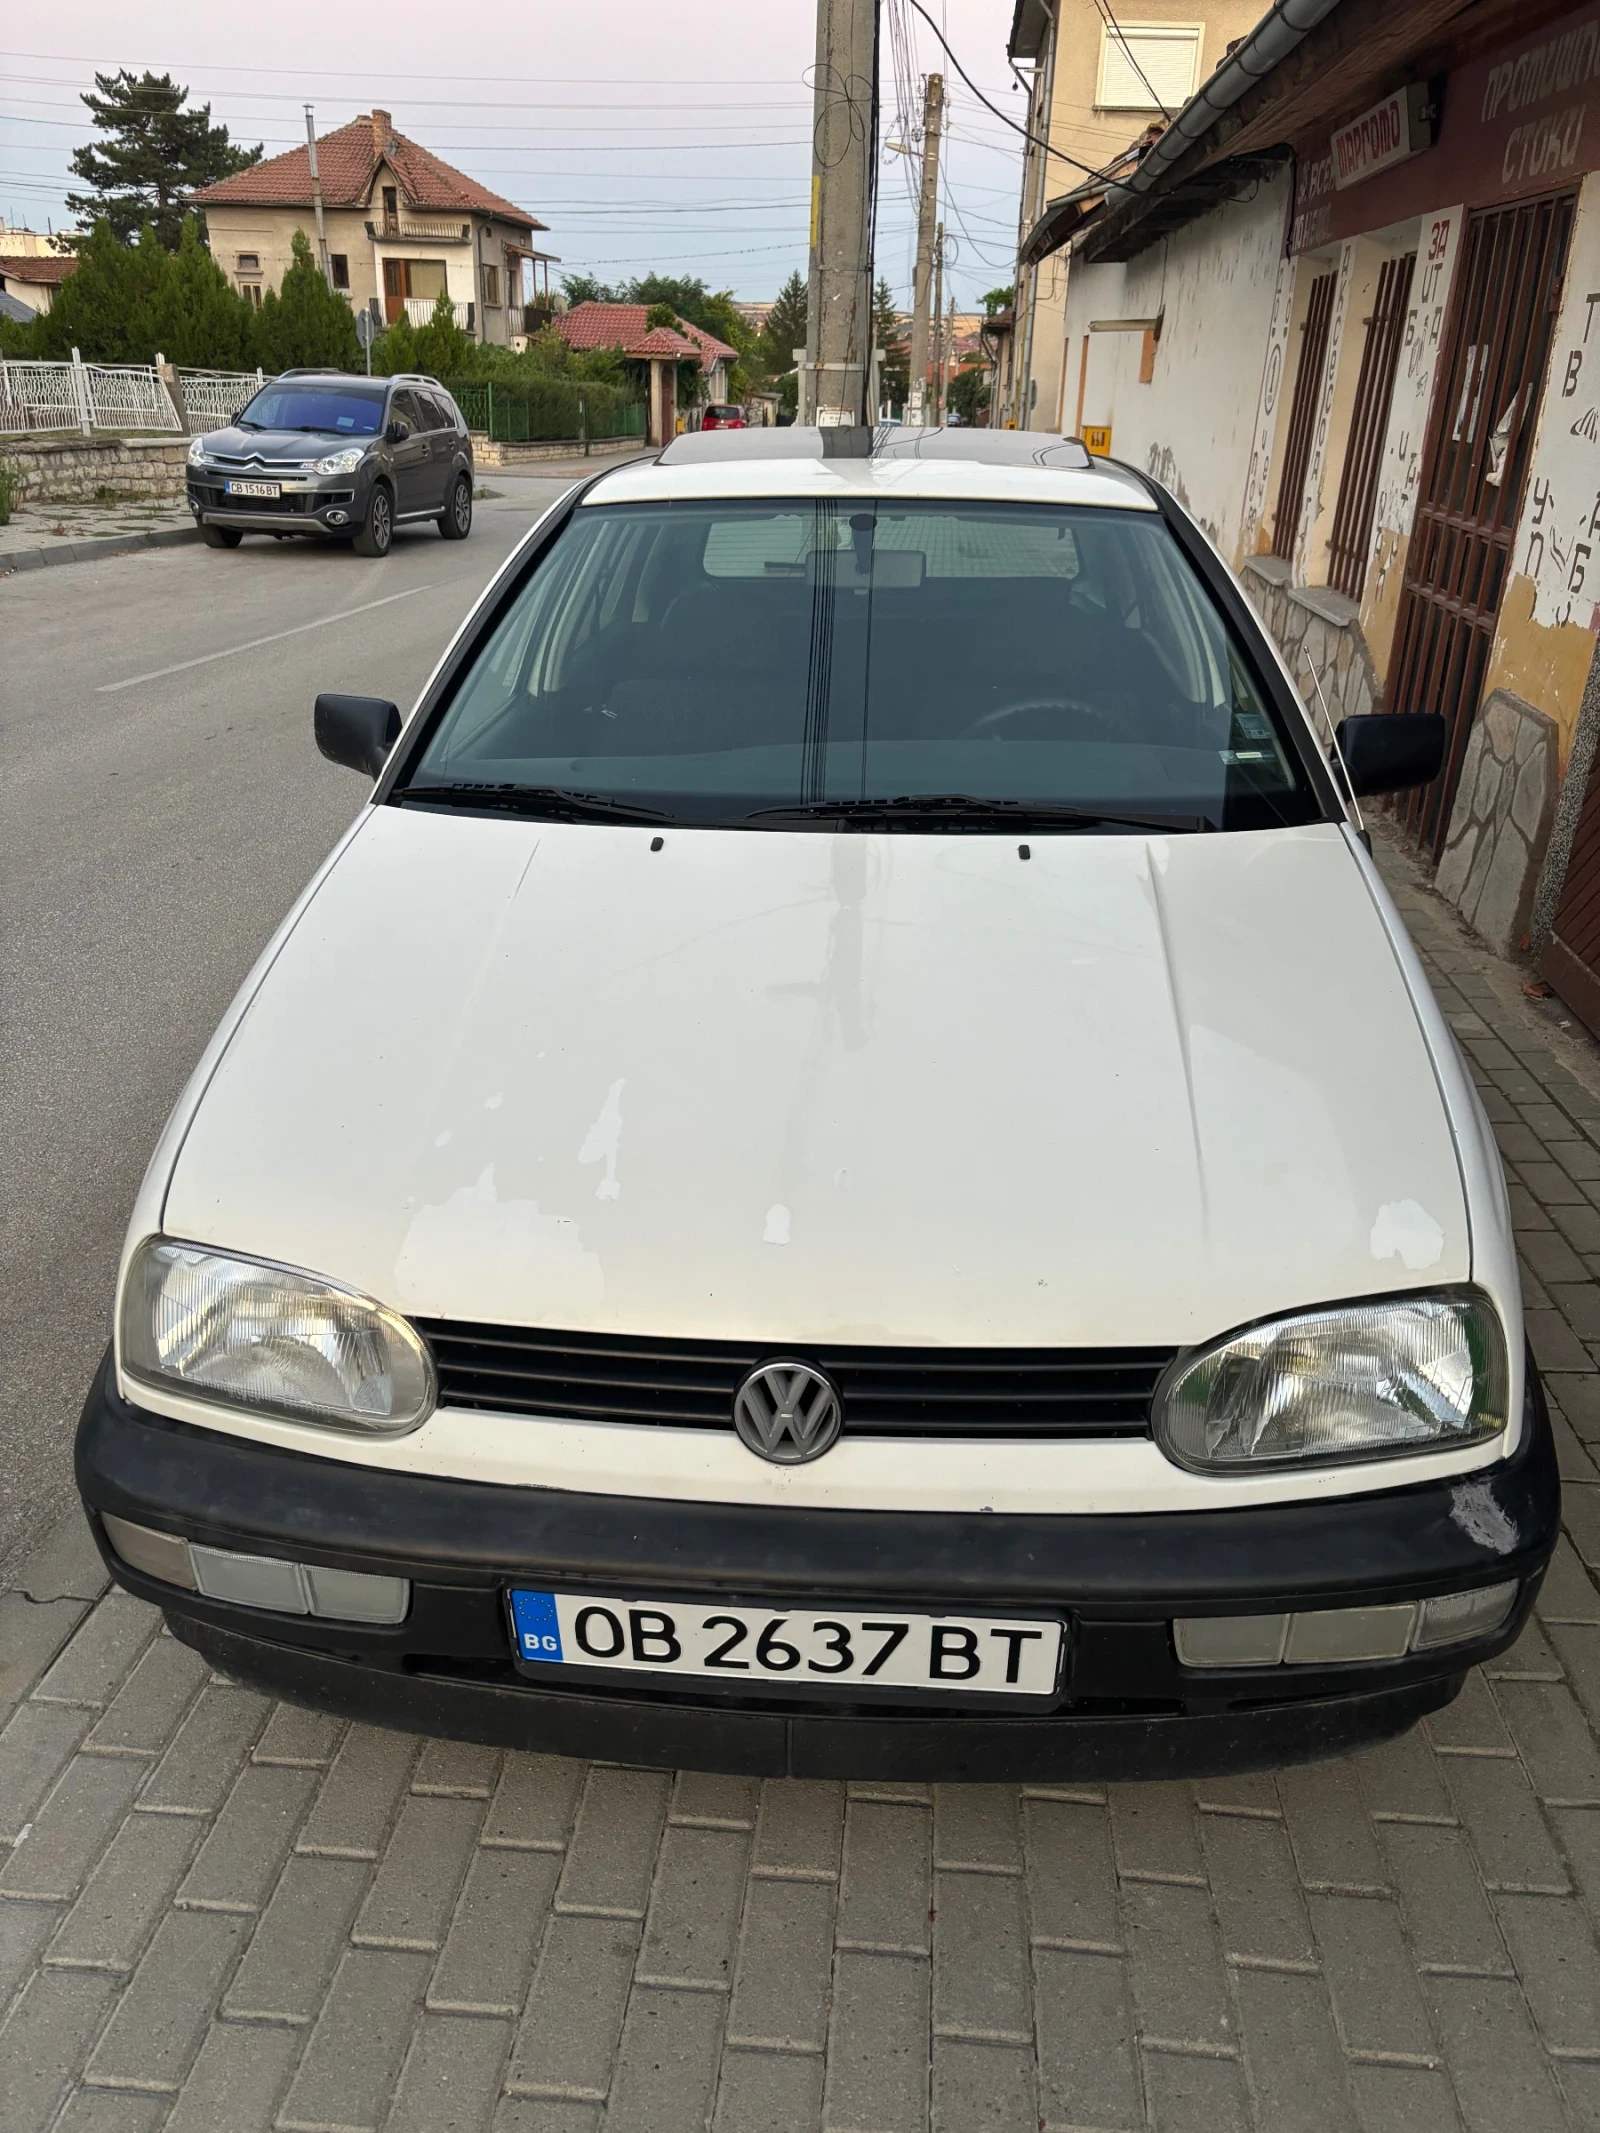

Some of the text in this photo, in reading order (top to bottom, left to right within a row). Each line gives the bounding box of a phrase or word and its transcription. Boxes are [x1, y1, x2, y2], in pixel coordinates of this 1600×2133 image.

[1502, 103, 1587, 184] СТОКИ
[1428, 219, 1451, 261] ЗА
[245, 484, 265, 495] 1516
[266, 485, 278, 496] BT
[524, 1632, 558, 1652] BG
[574, 1605, 1043, 1683] OB 2637 BT
